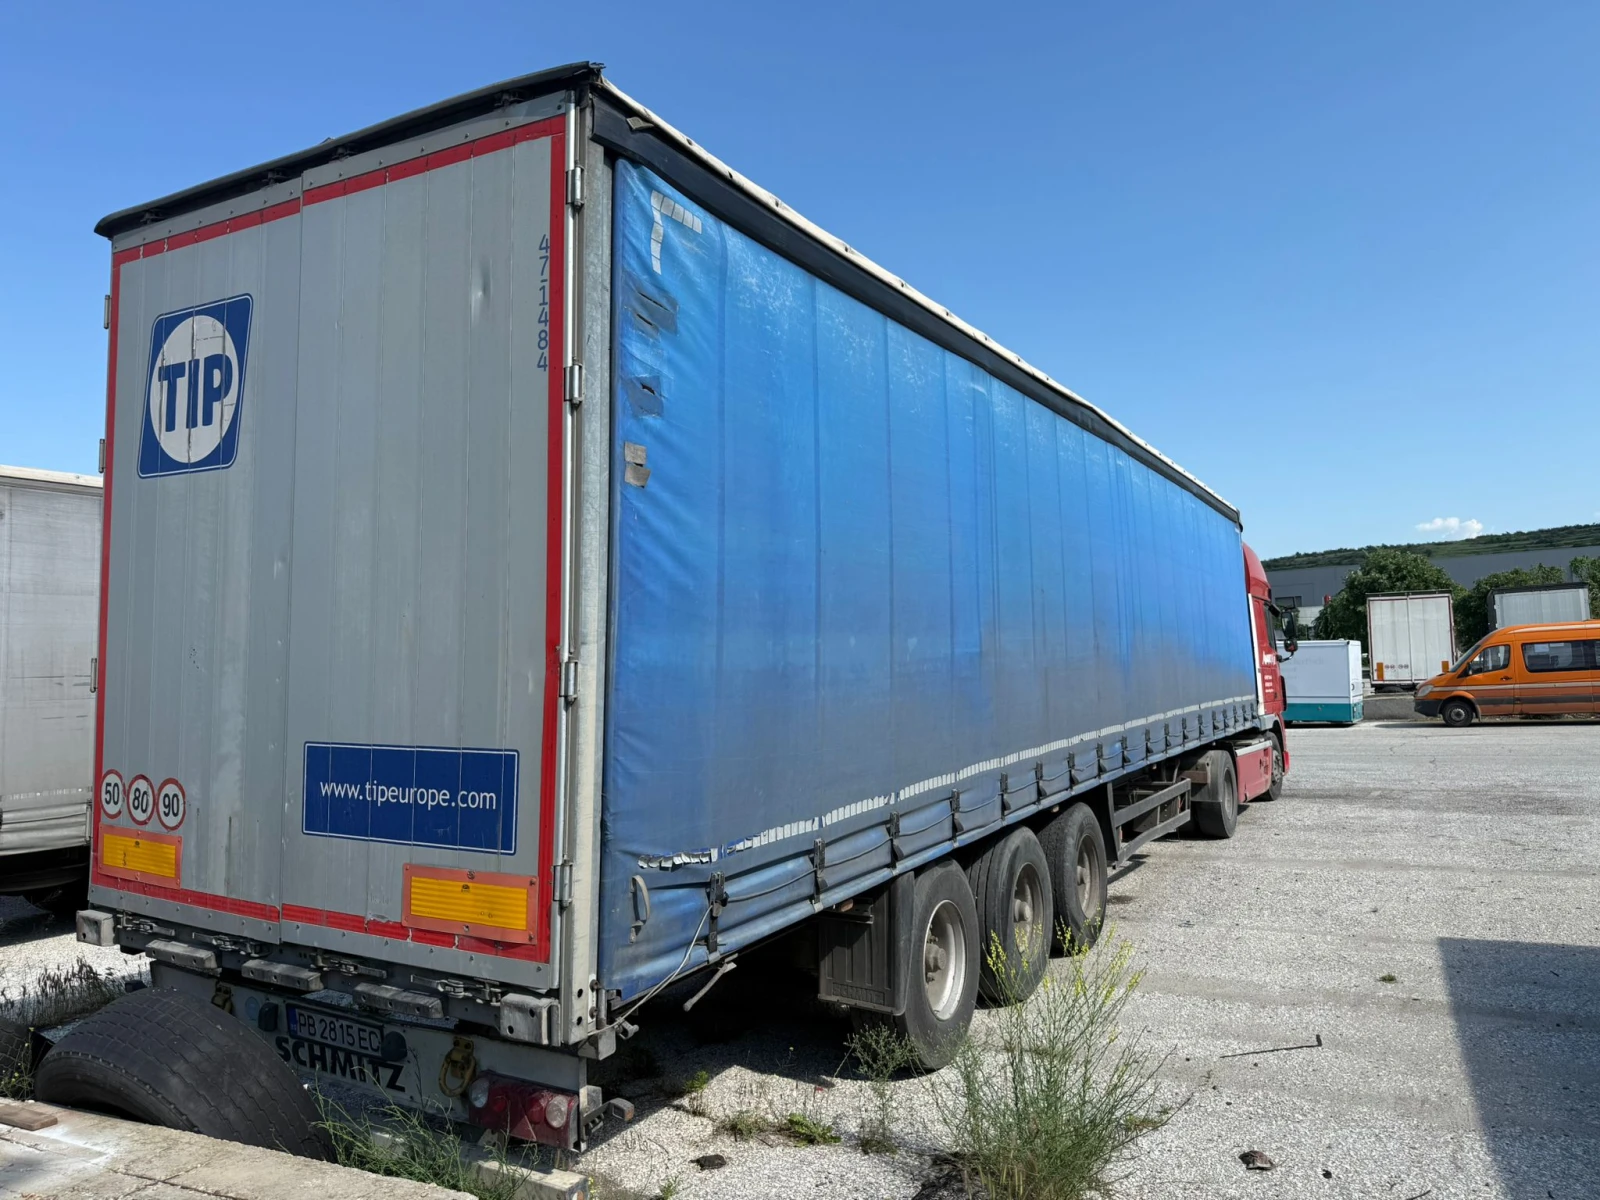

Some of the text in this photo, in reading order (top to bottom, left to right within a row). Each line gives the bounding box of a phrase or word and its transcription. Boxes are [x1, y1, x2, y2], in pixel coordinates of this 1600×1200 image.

[536, 233, 550, 372] 47-1484
[157, 353, 233, 433] TIP
[104, 782, 120, 806] 50
[132, 787, 149, 814] 80
[162, 793, 180, 818] 90
[319, 779, 497, 811] www.tipeurope.com
[298, 1012, 317, 1036] PB
[319, 1018, 356, 1046] 2815
[275, 1035, 406, 1093] SCHMITZ
